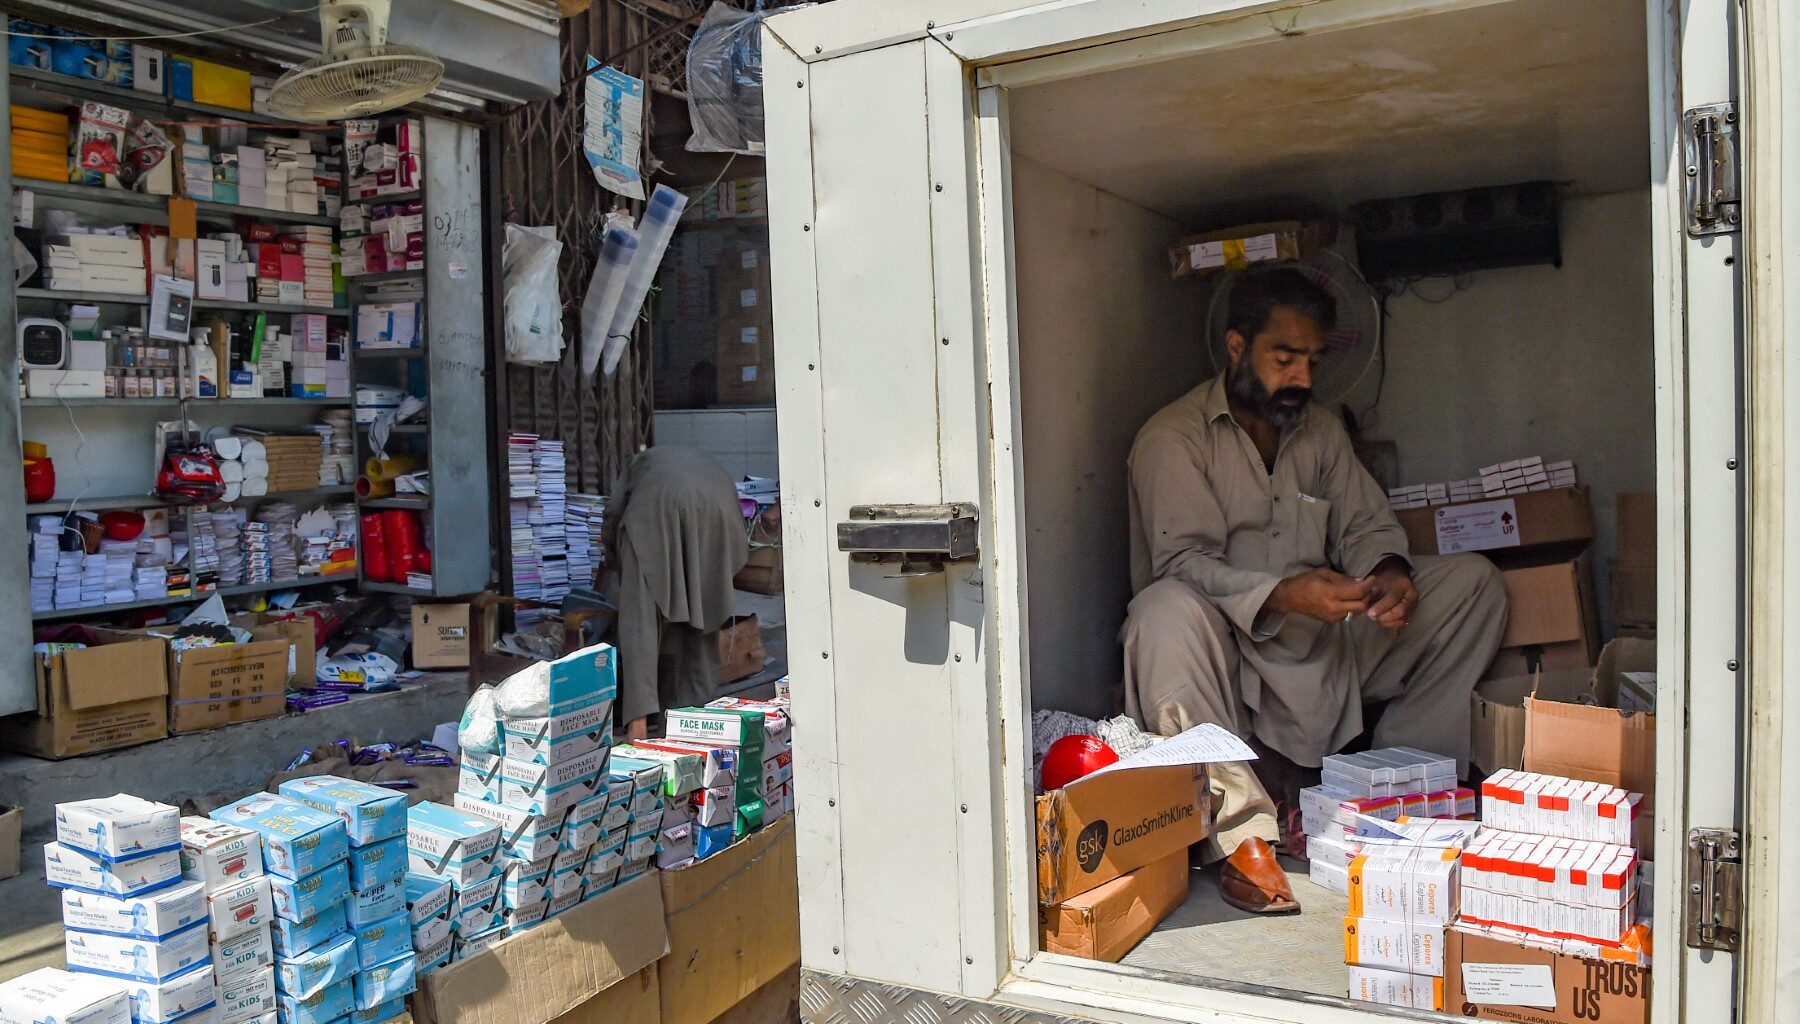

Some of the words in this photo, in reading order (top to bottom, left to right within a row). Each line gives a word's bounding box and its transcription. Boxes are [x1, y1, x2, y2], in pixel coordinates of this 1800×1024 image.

[1502, 525, 1514, 534] UP
[560, 708, 601, 727] DISPOSABLE
[680, 720, 699, 729] FACE
[702, 721, 724, 730] MASK
[562, 724, 579, 736] FACE
[582, 717, 600, 728] MASK
[506, 764, 536, 776] DISPOSABLE
[557, 756, 598, 776] DISPOSABLE
[559, 771, 575, 782] FACE
[578, 764, 595, 776] MASK
[360, 804, 385, 816] EXAM
[463, 801, 512, 821] DISPOSABLE
[1113, 804, 1193, 846] GlaxoSmithKline
[225, 840, 244, 850] KIDS
[296, 832, 320, 848] EXAM
[417, 841, 437, 853] MASK
[464, 835, 494, 850] DISPOSABLE
[1078, 829, 1104, 865] gsk
[362, 846, 385, 860] EXAM
[466, 846, 479, 856] FACE
[480, 841, 494, 850] MASK
[337, 864, 344, 872] 50
[297, 874, 322, 891] EXAM
[393, 878, 402, 886] 50
[236, 886, 256, 897] KIDS
[464, 884, 494, 899] DISPOSABLE
[466, 895, 478, 905] FACE
[480, 890, 494, 898] MASK
[1428, 882, 1437, 914] Ceporex
[418, 890, 446, 912] DISPOSABLE
[421, 906, 433, 917] FACE
[435, 899, 446, 910] MASK
[70, 910, 83, 918] Surgical
[361, 926, 384, 940] EXAM
[236, 950, 256, 964] KIDS
[418, 938, 448, 961] DISPOSABLE
[421, 955, 434, 966] FACE
[436, 948, 449, 958] MASK
[1424, 934, 1432, 965] Ceporex
[1582, 958, 1651, 999] TRUST
[238, 994, 260, 1009] KIDS
[1573, 987, 1600, 1021] US
[1483, 1007, 1521, 1019] FEROZSONS
